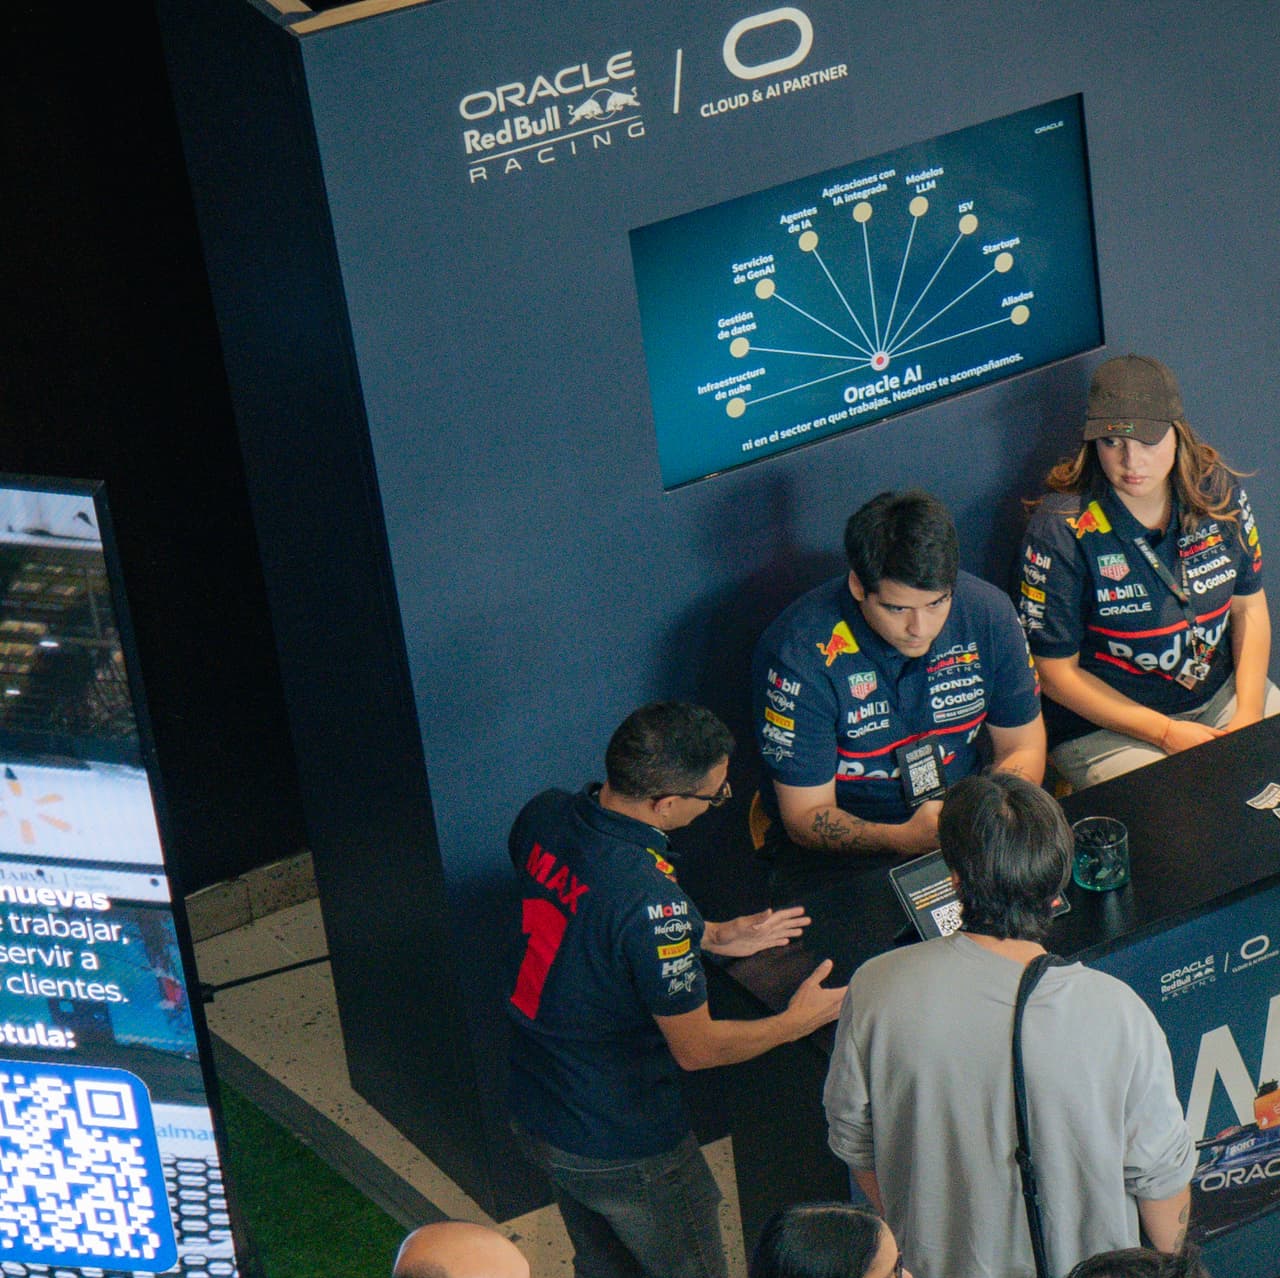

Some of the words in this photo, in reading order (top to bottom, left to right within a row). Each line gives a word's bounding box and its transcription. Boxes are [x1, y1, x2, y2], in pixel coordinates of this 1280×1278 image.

[459, 50, 635, 120] ORACLE
[700, 93, 749, 118] CLOUD
[751, 89, 764, 103] &
[765, 82, 781, 101] AI
[782, 64, 848, 95] PARTNER
[463, 119, 512, 154] Red
[516, 105, 561, 141] Bull
[1034, 120, 1064, 135] ORACLE
[469, 121, 645, 184] RACING
[821, 172, 878, 199] Aplicaciones
[879, 168, 896, 181] con
[905, 167, 944, 186] Modelos
[916, 180, 936, 194] LLM
[832, 195, 844, 207] IA
[845, 182, 888, 204] integrada
[779, 206, 818, 226] Agentes
[958, 201, 974, 214] ISV
[788, 222, 800, 234] de
[800, 219, 812, 230] IA
[982, 236, 1020, 256] Startups
[731, 254, 774, 273] Servicios
[733, 274, 746, 285] de
[747, 264, 775, 281] GenAI
[1001, 290, 1034, 308] Aliados
[718, 311, 754, 328] Gestión
[717, 329, 730, 340] de
[731, 322, 757, 337] datos
[698, 367, 766, 395] Infraestructura
[715, 390, 728, 401] de
[728, 383, 752, 397] nube
[844, 373, 900, 404] Oracle
[903, 364, 923, 386] AI
[742, 440, 753, 452] ni
[754, 436, 768, 449] en
[769, 430, 779, 443] el
[780, 422, 812, 440] sector
[813, 417, 827, 428] en
[828, 410, 848, 427] que
[848, 396, 892, 418] trabajas.
[892, 381, 938, 402] Nosotros
[938, 376, 950, 387] te
[950, 353, 1024, 385] acompañamos.
[1025, 545, 1051, 571] Mobil
[1101, 555, 1124, 566] TAG
[1187, 554, 1232, 579] HONDA
[1097, 585, 1133, 602] Mobil
[1099, 602, 1153, 617] ORACLE
[767, 668, 801, 696] Mobil
[850, 672, 876, 684] TAG
[929, 674, 984, 696] HONDA
[848, 703, 875, 724] Mobil
[847, 719, 890, 739] ORACLE
[526, 842, 590, 916] MAX
[0, 884, 110, 912] nuevas
[648, 901, 688, 920] Mobil
[9, 912, 130, 946] trabajar,
[0, 945, 78, 970] servir
[80, 953, 99, 972] a
[510, 898, 568, 1021] 1
[1161, 955, 1215, 984] ORACLE
[7, 970, 128, 1004] clientes.
[0, 1021, 76, 1049] stula:
